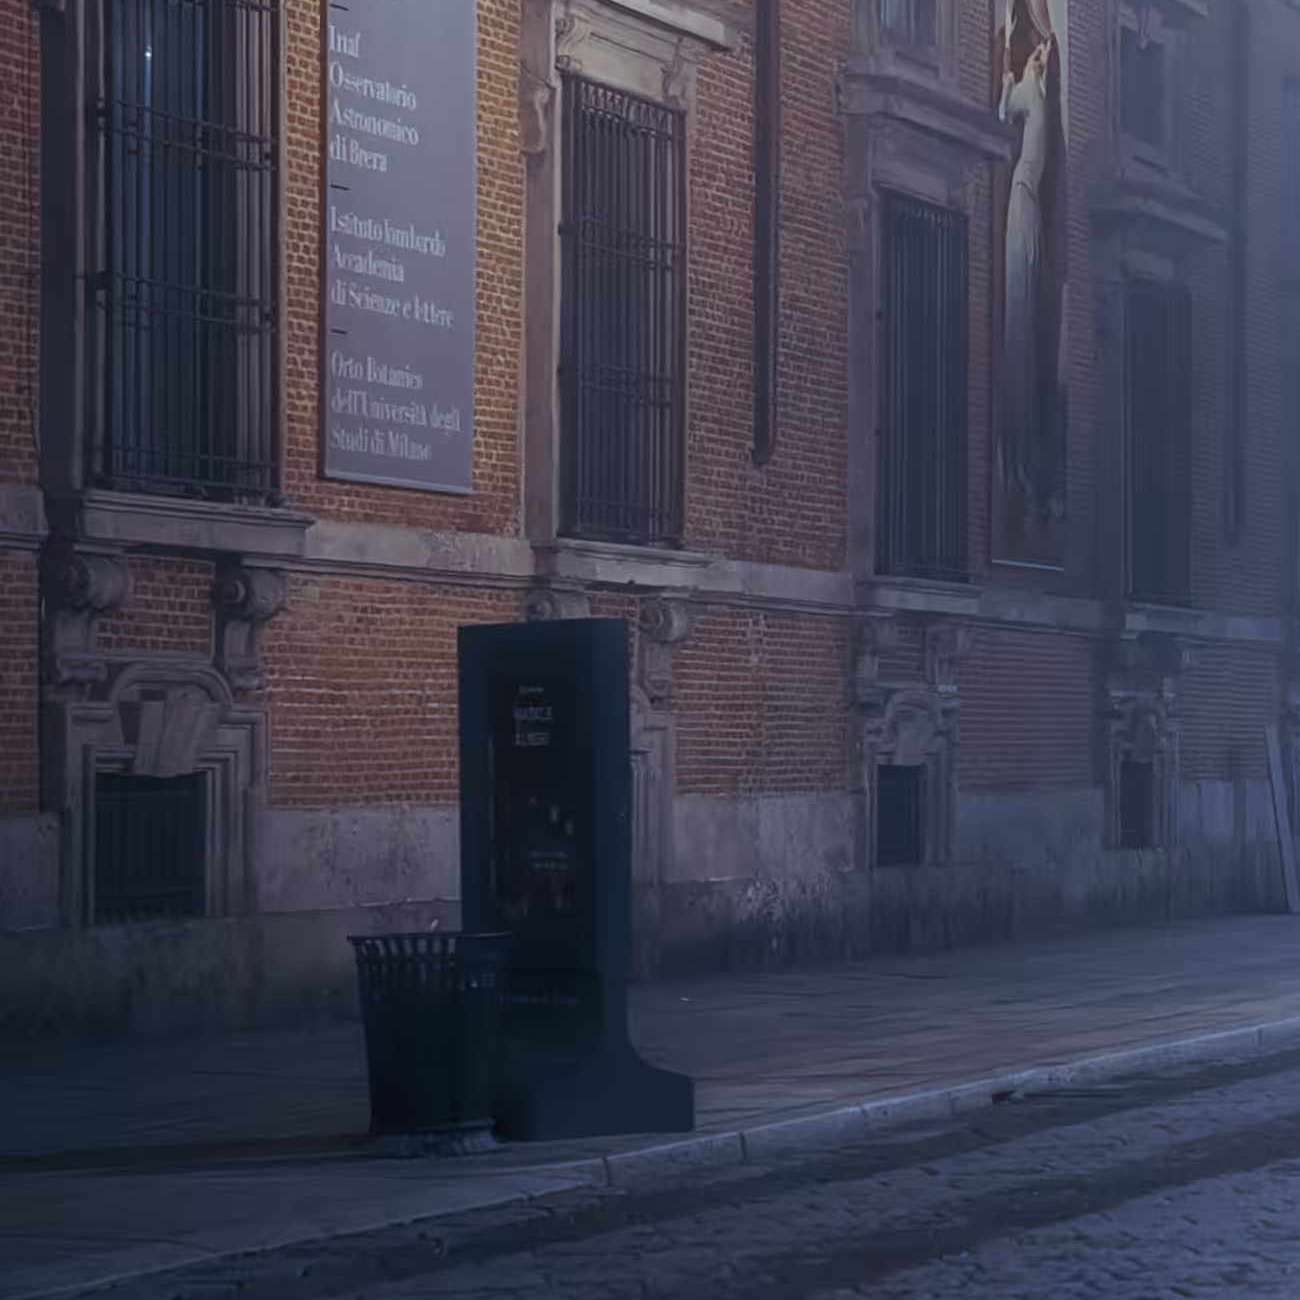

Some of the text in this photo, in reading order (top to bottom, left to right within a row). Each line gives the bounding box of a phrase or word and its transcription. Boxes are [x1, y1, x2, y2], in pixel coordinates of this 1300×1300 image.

[329, 25, 361, 58] Inaf
[329, 61, 417, 111] Osservatorio
[330, 97, 419, 145] Astronomico
[330, 134, 388, 172] di Brera
[331, 205, 382, 241] Istituto
[331, 243, 404, 282] Accademia
[331, 279, 346, 305] di
[348, 282, 400, 317] Scienze
[402, 302, 411, 319] e
[331, 350, 423, 390] Orto Botanico
[430, 403, 461, 436] degli
[331, 423, 433, 460] Studi di Milano
